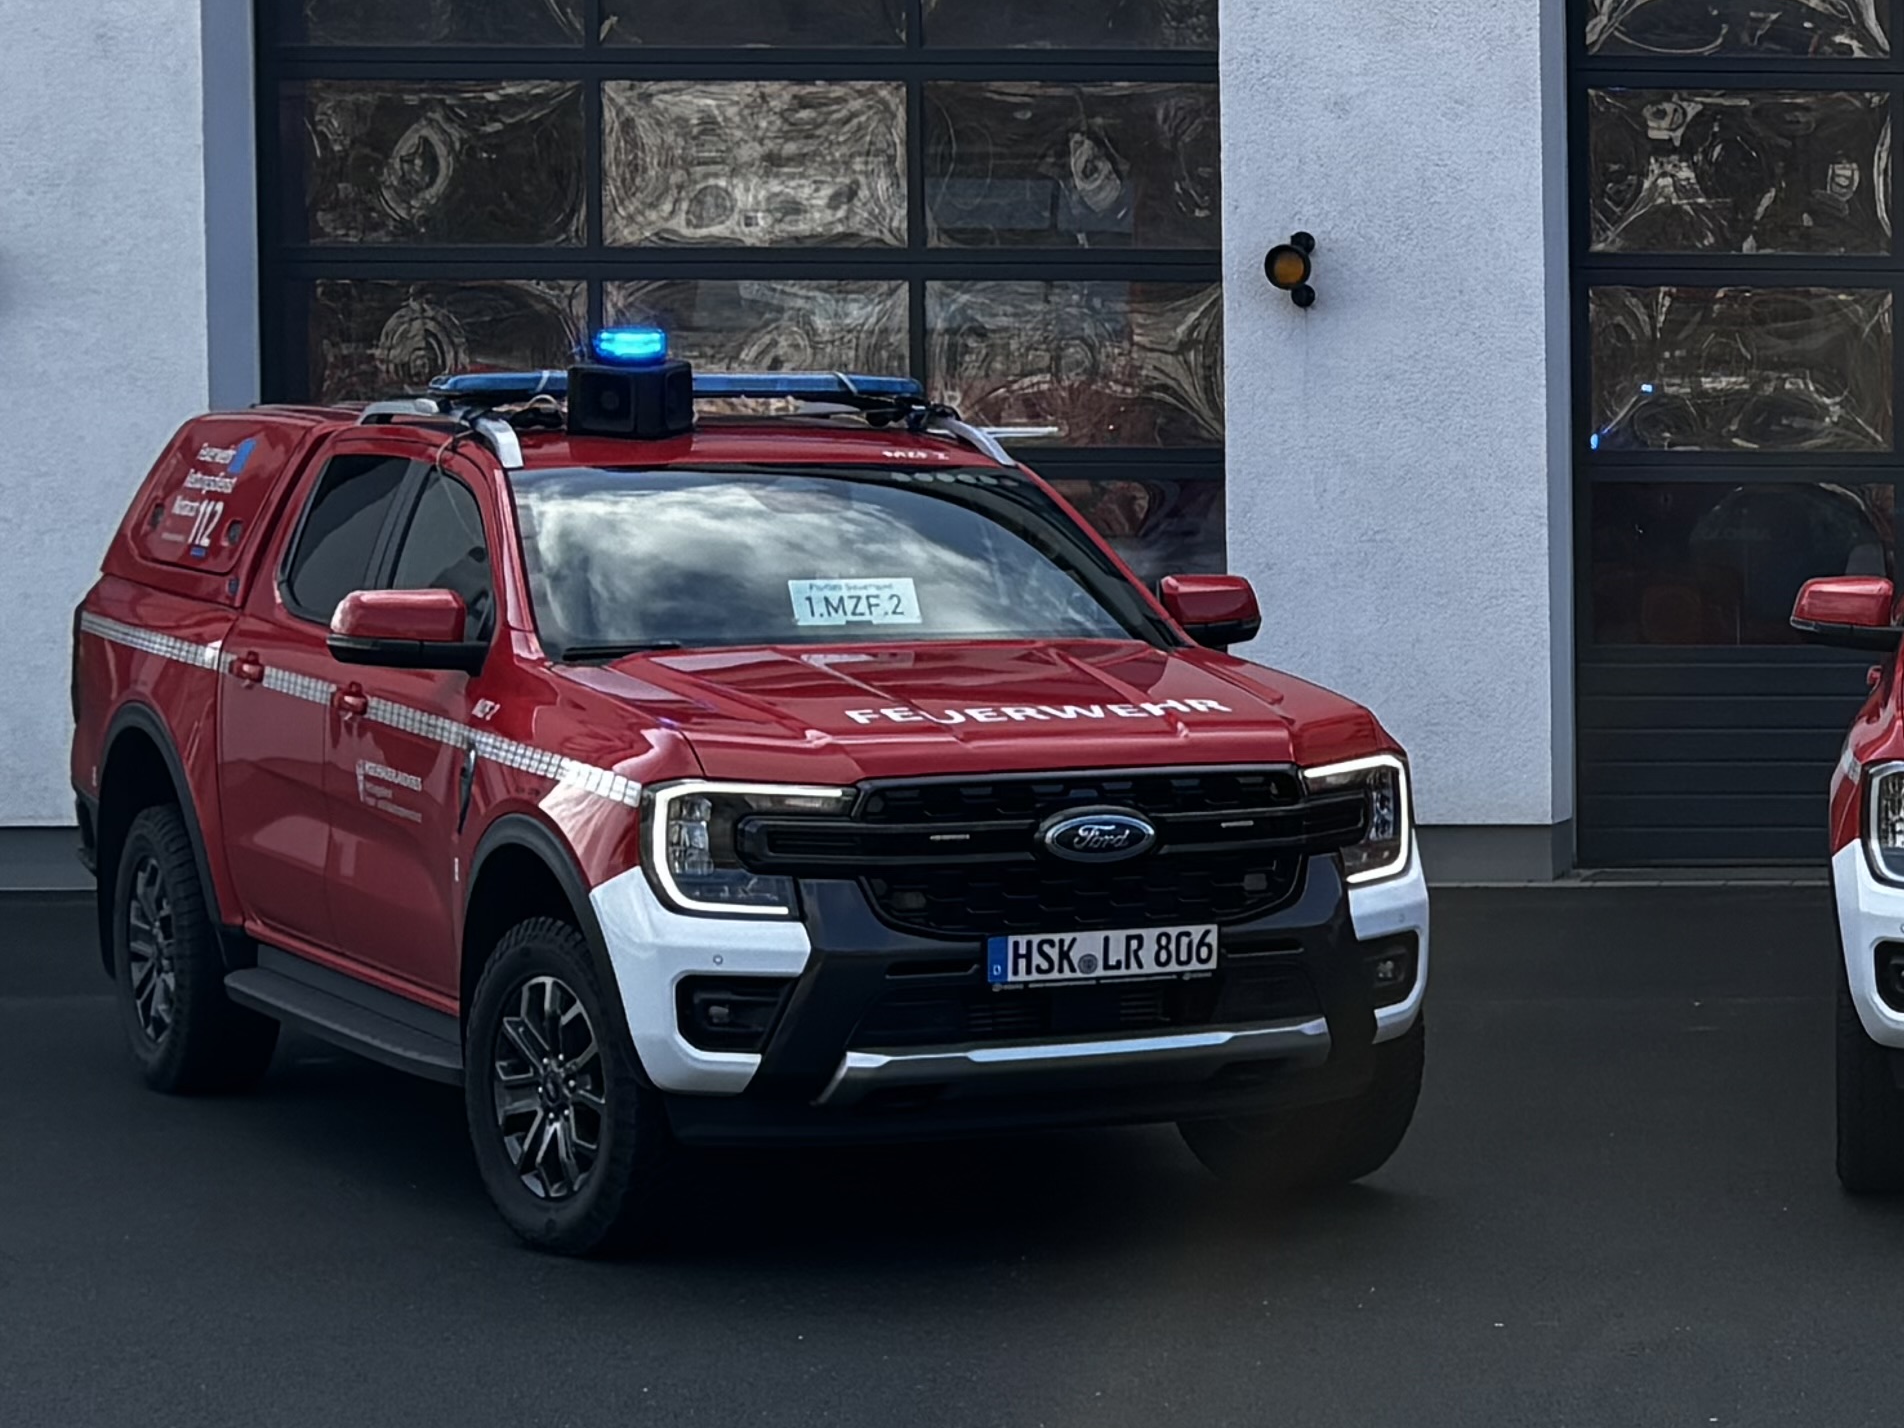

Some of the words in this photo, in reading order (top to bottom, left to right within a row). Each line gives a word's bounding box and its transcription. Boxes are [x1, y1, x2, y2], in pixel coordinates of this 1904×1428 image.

[187, 499, 225, 548] 112
[805, 594, 905, 618] 1.MZF.2
[845, 698, 1232, 725] FEUERWEHR
[1073, 824, 1130, 851] Ford
[1011, 937, 1078, 977] HSK
[1102, 933, 1145, 972] LR
[1154, 929, 1213, 968] 806
